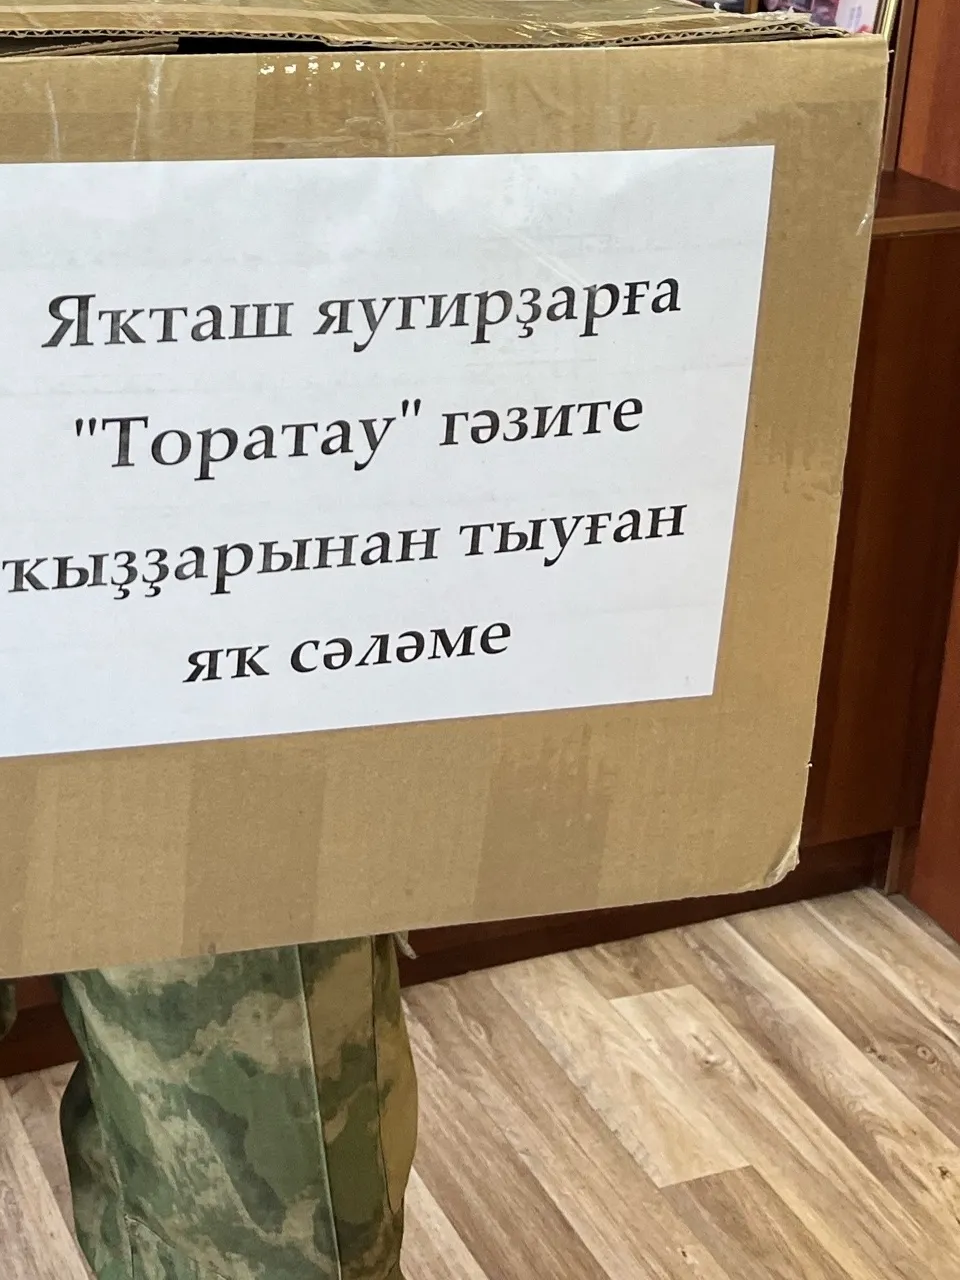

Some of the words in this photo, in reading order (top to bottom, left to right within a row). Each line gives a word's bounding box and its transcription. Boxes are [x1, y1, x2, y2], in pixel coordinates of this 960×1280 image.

[313, 276, 681, 353] яугирҙарға
[75, 398, 421, 481] "Торатау"
[439, 396, 643, 446] гәзите
[459, 504, 688, 567] тыуған
[290, 621, 512, 674] сәләме
